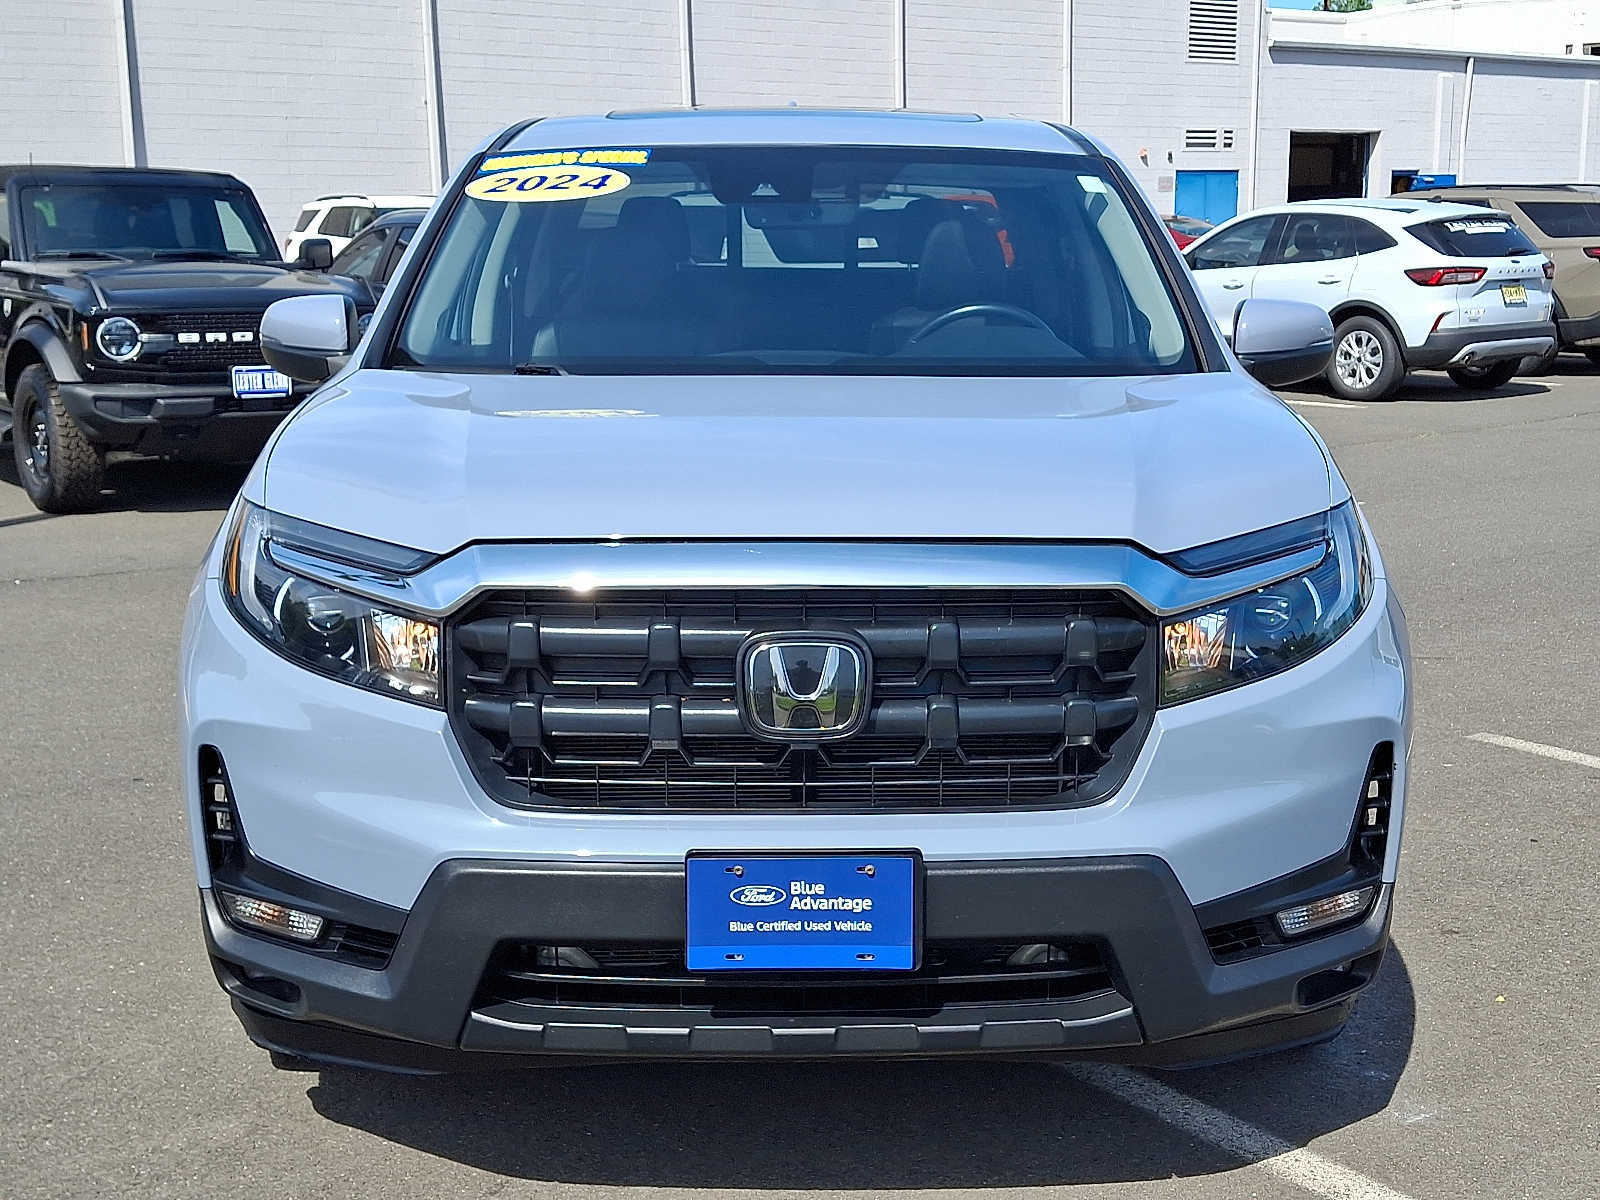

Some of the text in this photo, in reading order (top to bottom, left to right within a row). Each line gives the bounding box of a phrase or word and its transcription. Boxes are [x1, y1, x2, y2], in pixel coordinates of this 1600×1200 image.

[482, 174, 613, 193] 2024
[177, 332, 254, 343] BRO
[739, 886, 777, 903] Ford
[790, 880, 825, 895] Blue
[789, 896, 873, 913] Advantage
[729, 920, 873, 932] Blue Certified Used Vehicle
